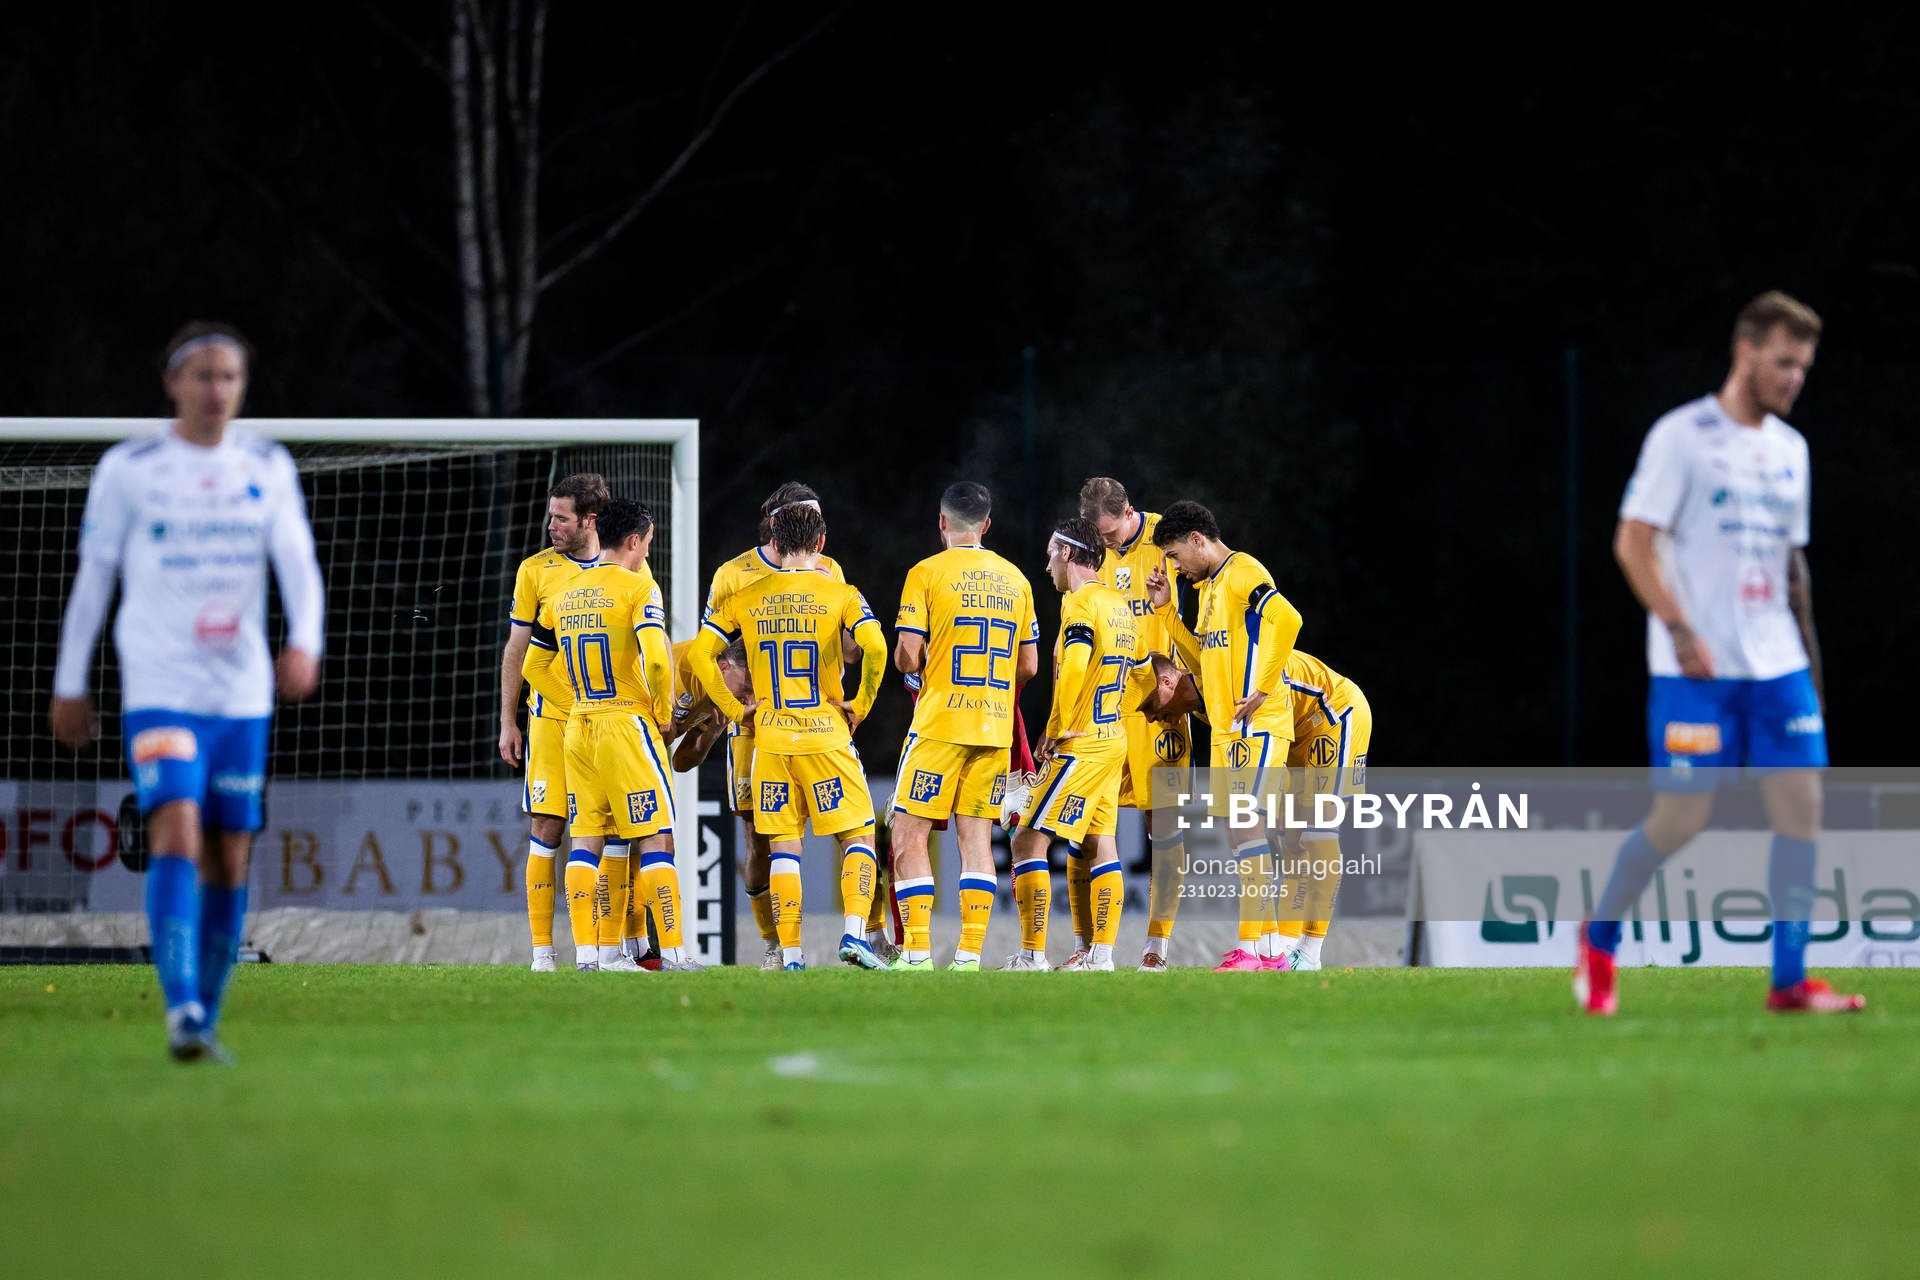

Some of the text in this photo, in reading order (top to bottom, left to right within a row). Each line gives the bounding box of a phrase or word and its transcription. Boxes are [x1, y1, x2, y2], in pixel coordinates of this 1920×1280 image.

[962, 570, 1009, 585] NORDIC
[564, 588, 604, 600] NORDIC
[951, 582, 1019, 598] WELLNESS
[556, 599, 614, 612] WELLNESS
[762, 594, 814, 604] NORDIC
[961, 594, 1013, 612] SELMANI
[750, 605, 828, 616] WELLNESS
[560, 613, 607, 631] CARNEIL
[757, 618, 816, 635] MUCOLLI
[951, 616, 1017, 690] 22
[561, 633, 617, 701] 10
[759, 640, 820, 709] 19
[1157, 732, 1184, 760] MG
[1228, 741, 1248, 768] MG
[1309, 737, 1335, 765] MG
[763, 783, 784, 793] EFF
[1168, 772, 1181, 787] 21
[1316, 776, 1328, 791] 17
[629, 792, 651, 804] EFF
[763, 792, 787, 802] EKT
[631, 801, 655, 812] EKT
[0, 808, 119, 874] FO
[656, 885, 675, 933] SILFVERLOK
[1033, 888, 1047, 934] SILFVERLOK
[1096, 887, 1112, 932] SILFVERLOK
